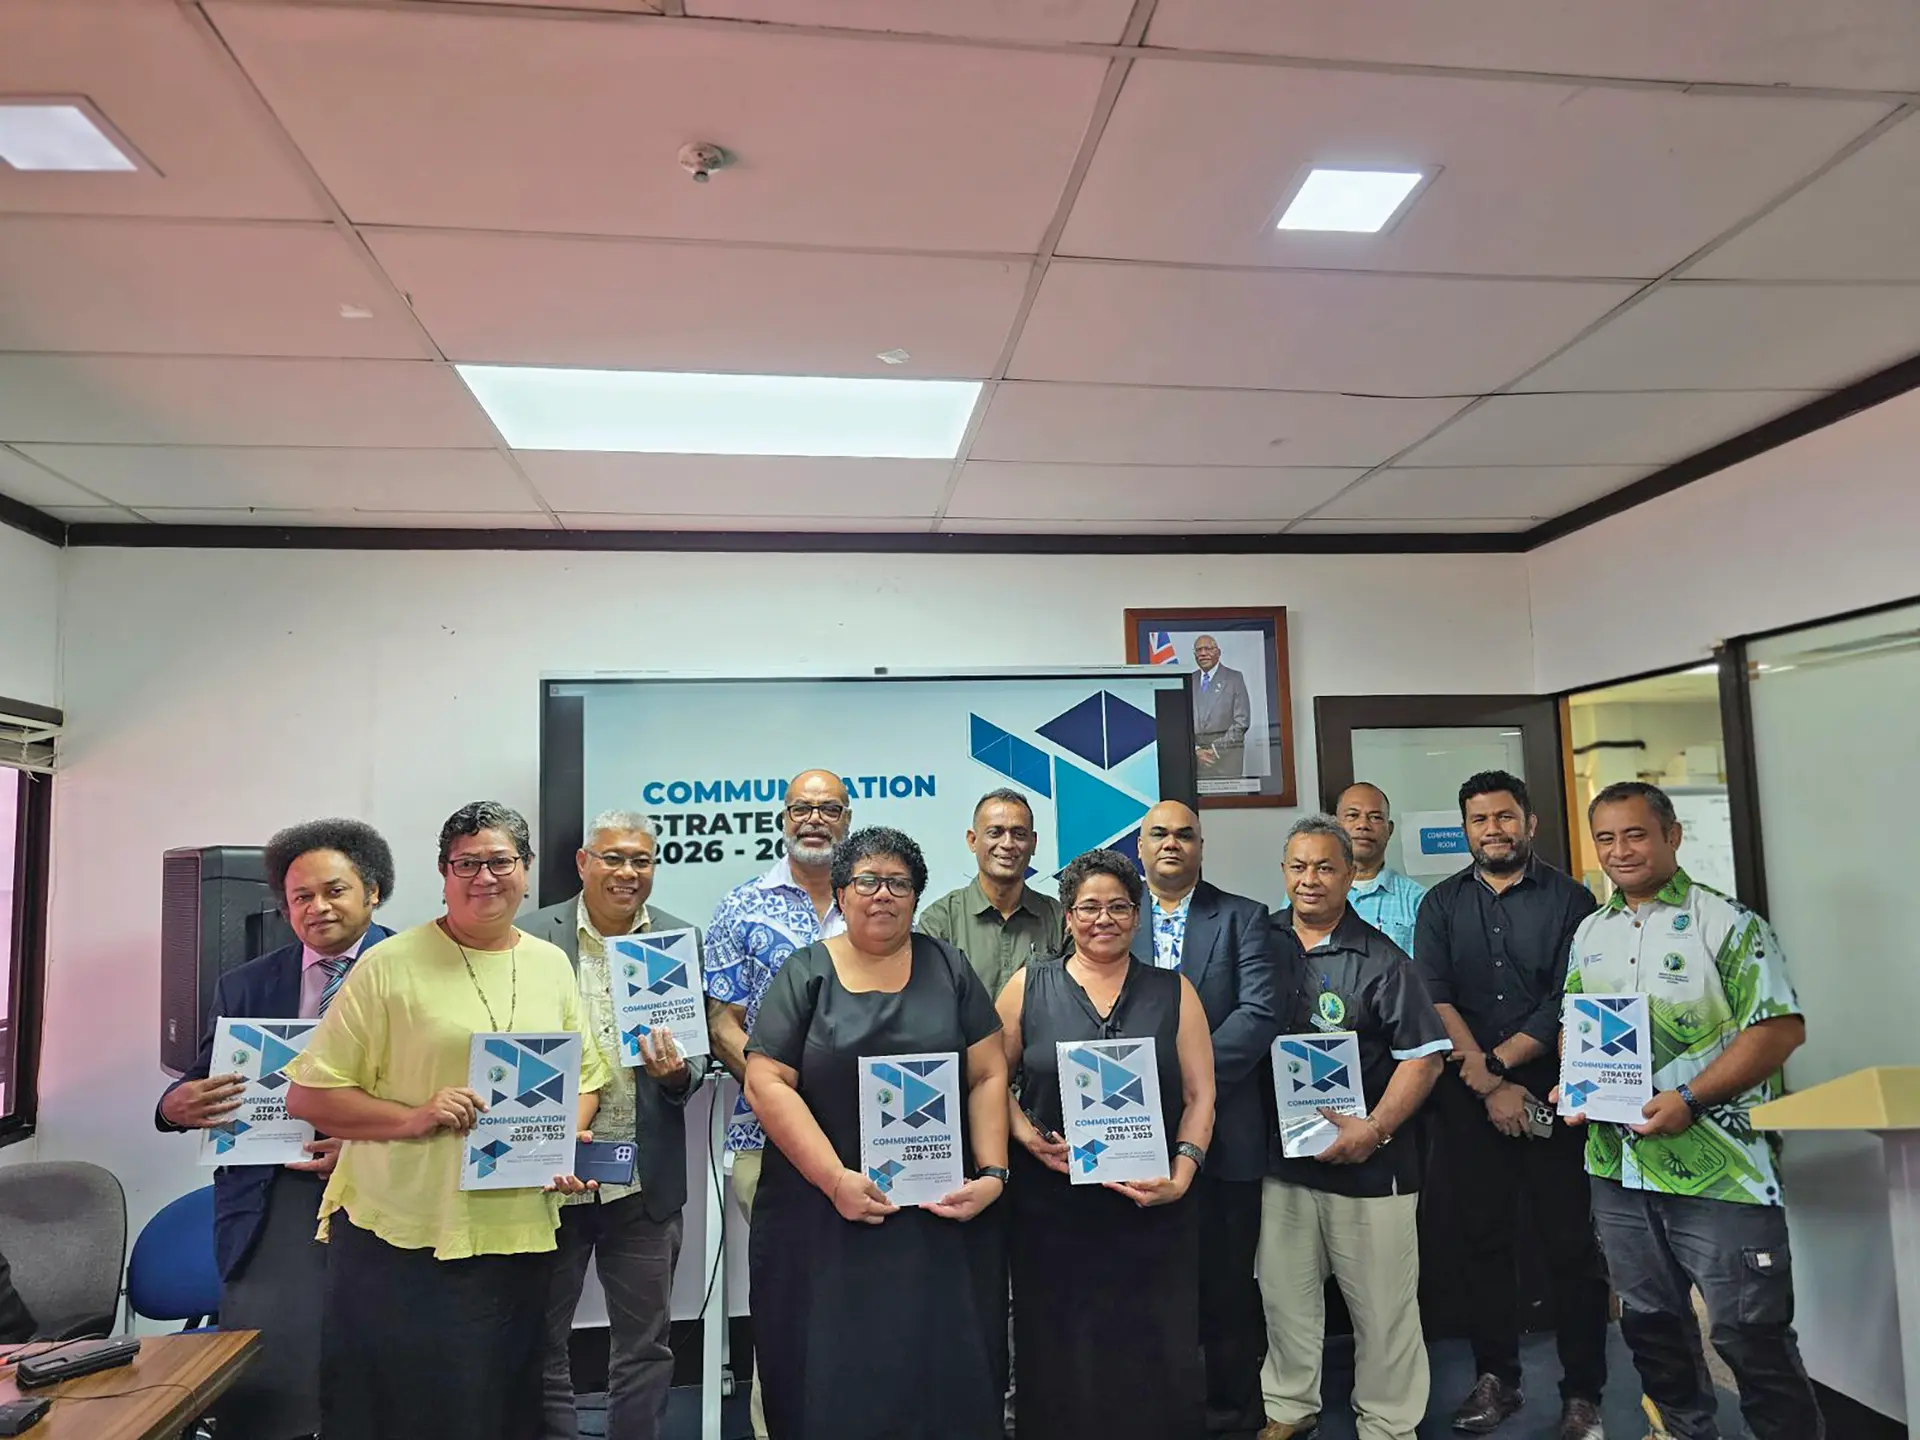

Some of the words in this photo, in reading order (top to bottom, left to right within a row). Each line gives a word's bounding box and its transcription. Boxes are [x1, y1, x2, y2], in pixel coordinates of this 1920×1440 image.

[643, 775, 936, 805] COMMUATION
[755, 838, 789, 861] 20
[622, 997, 695, 1013] COMMUNICATION
[651, 1005, 695, 1018] STRATEGY
[1572, 1061, 1642, 1070] COMMUNICATION
[1601, 1070, 1642, 1078] STRATEGY
[1624, 1078, 1643, 1086] 2029
[1287, 1096, 1356, 1107] COMMUNICATION
[256, 1105, 287, 1113] STRAT
[250, 1113, 274, 1121] 2026
[479, 1115, 566, 1125] COMMUNICATION
[1074, 1115, 1151, 1127] COMMUNICATION
[514, 1125, 566, 1134] STRATEGY
[1106, 1124, 1152, 1134] STRATEGY
[510, 1133, 534, 1142] 2026
[873, 1134, 951, 1146] COMMUNICATION
[1104, 1133, 1125, 1141] 2026
[1132, 1131, 1153, 1139] 2029
[905, 1143, 952, 1153] STRATEGY
[902, 1152, 923, 1161] 2026
[930, 1151, 952, 1160] 2029
